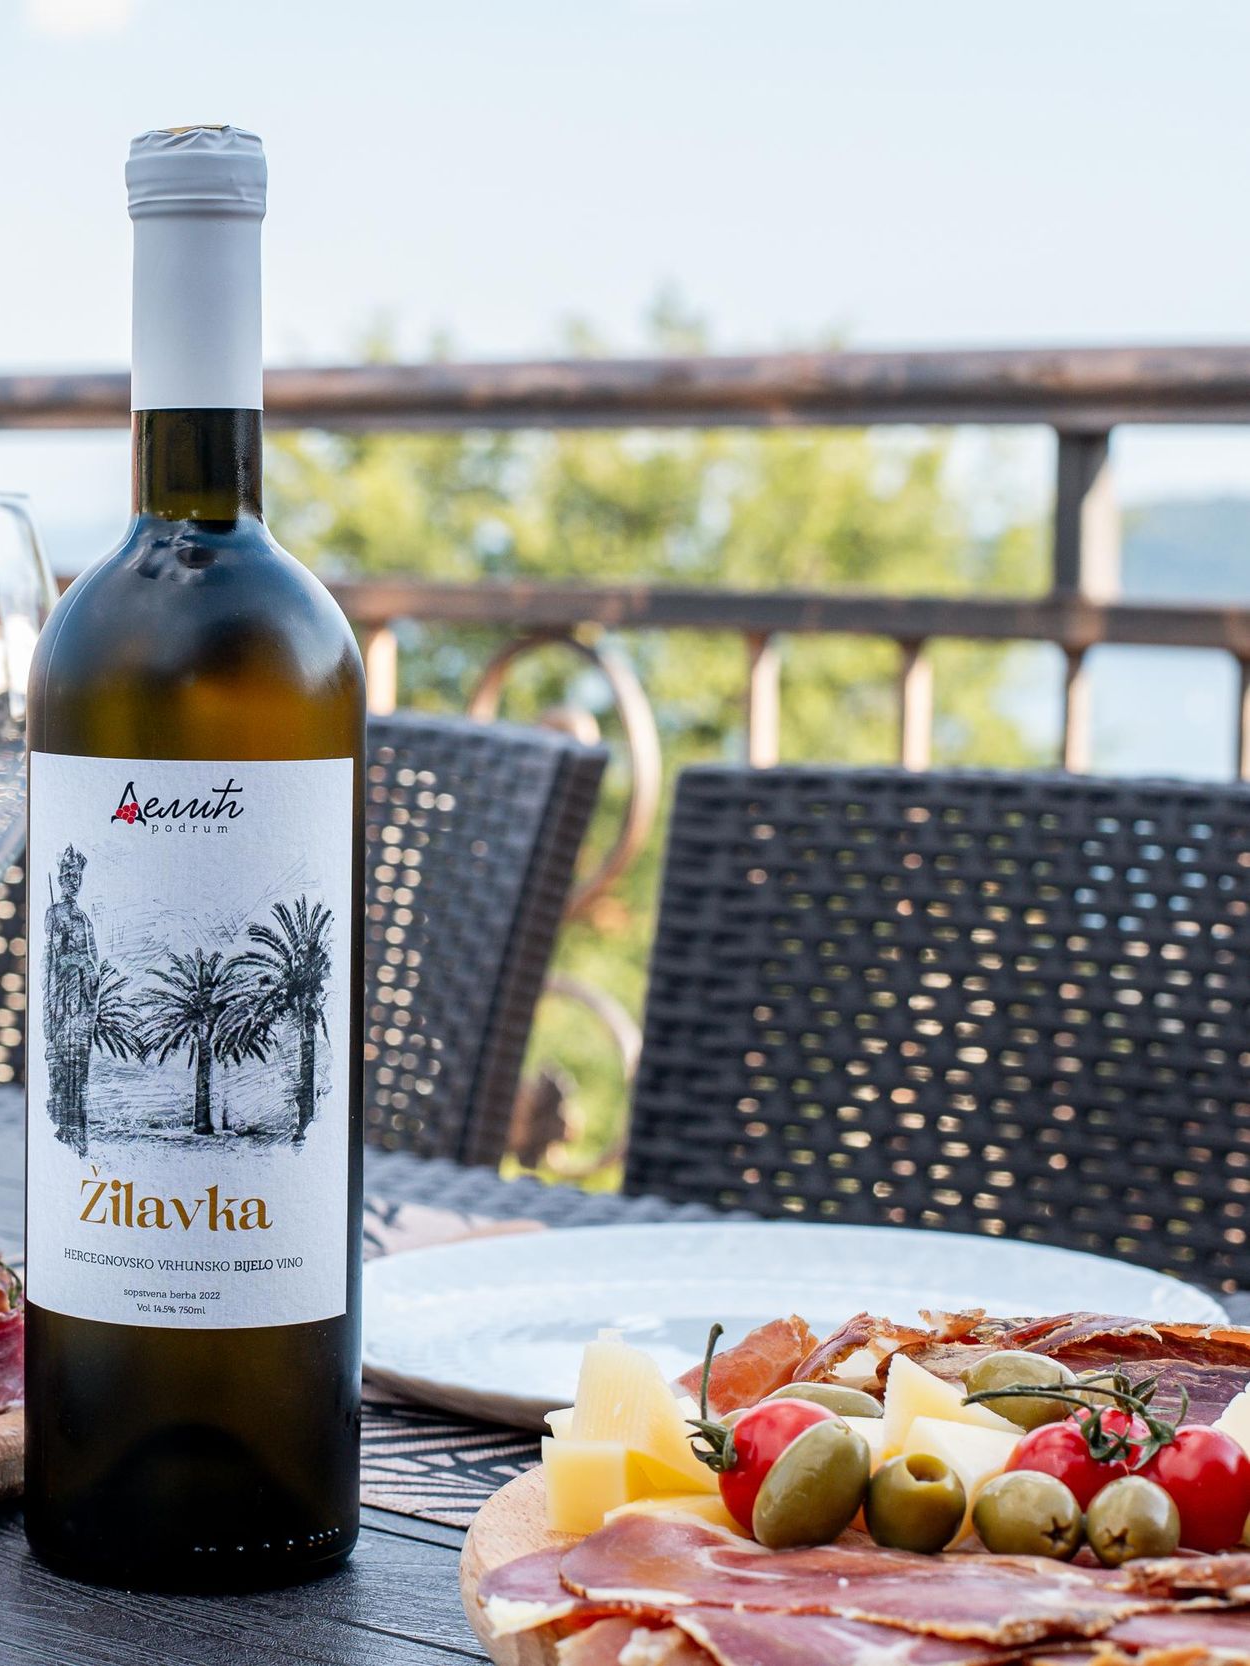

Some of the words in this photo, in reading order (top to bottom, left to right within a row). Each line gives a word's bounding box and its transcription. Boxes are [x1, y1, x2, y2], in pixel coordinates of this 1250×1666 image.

[111, 778, 244, 826] Делић
[151, 823, 228, 834] podrum
[79, 1164, 274, 1232] Žilavka
[64, 1247, 154, 1270] HERCEGNOVSKO
[158, 1259, 230, 1272] VRHUNSKO
[234, 1259, 274, 1273] BIJELO
[276, 1256, 303, 1269] VINO
[123, 1288, 167, 1299] sopstvena
[169, 1289, 197, 1300] berba
[199, 1291, 221, 1300] 2022
[178, 1306, 206, 1315] 750ml
